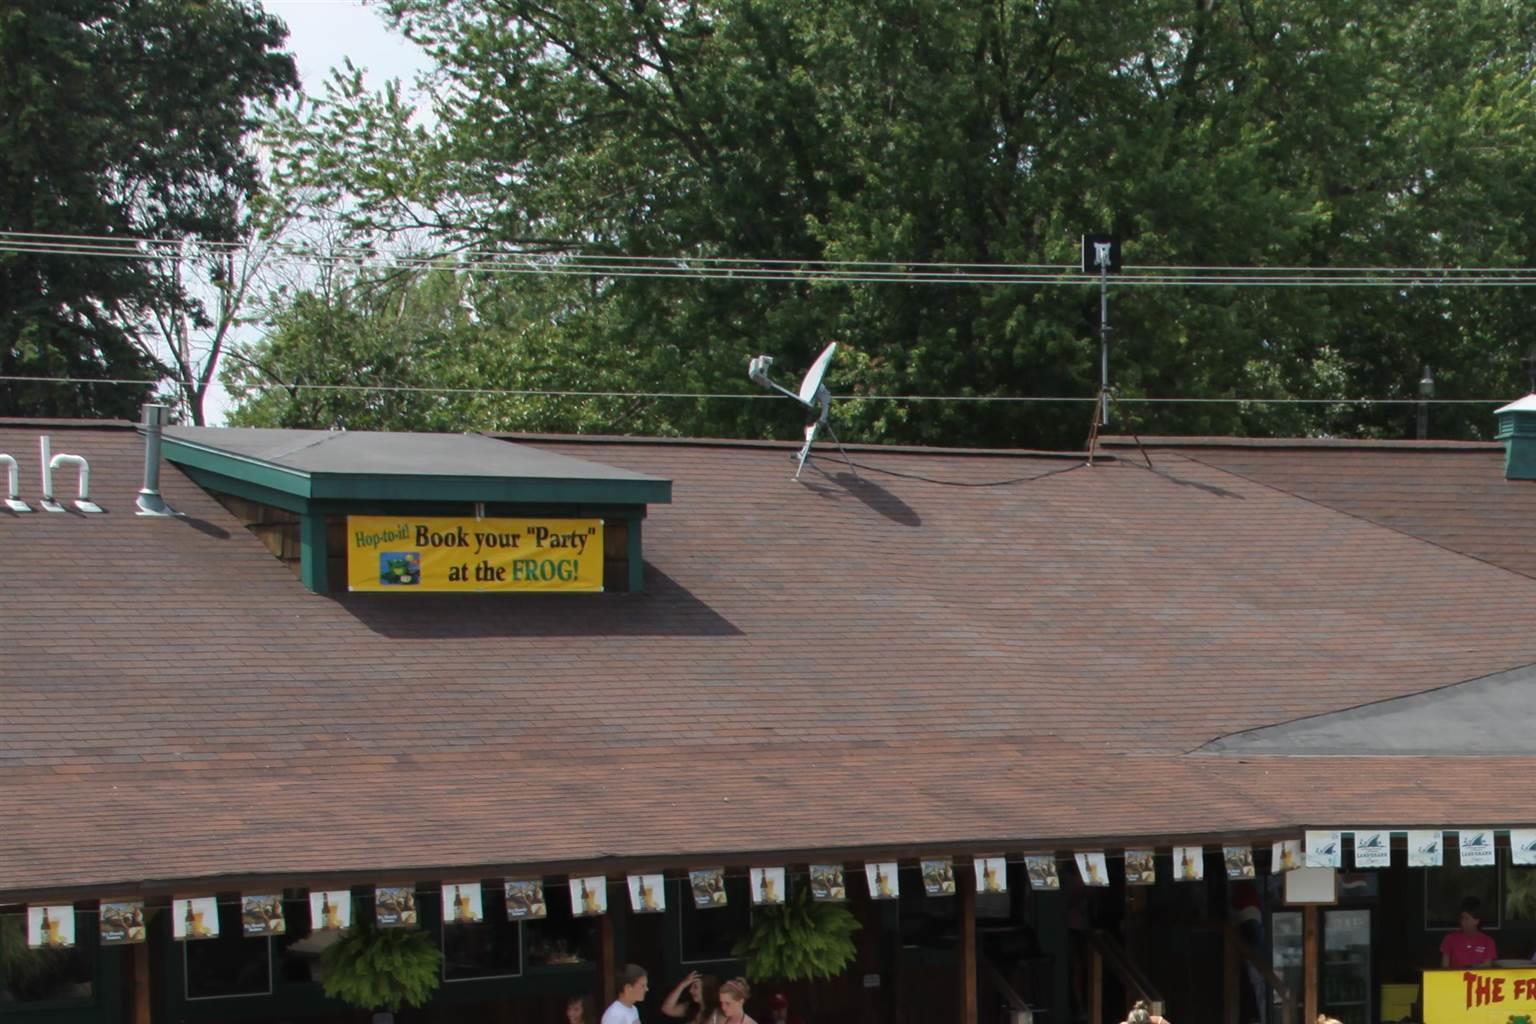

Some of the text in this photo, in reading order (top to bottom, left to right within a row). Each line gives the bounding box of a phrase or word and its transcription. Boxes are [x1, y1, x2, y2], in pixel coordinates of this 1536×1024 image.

[415, 525, 596, 555] Book your "Party"
[448, 559, 579, 582] at the FROG!
[1463, 971, 1505, 1010] THE
